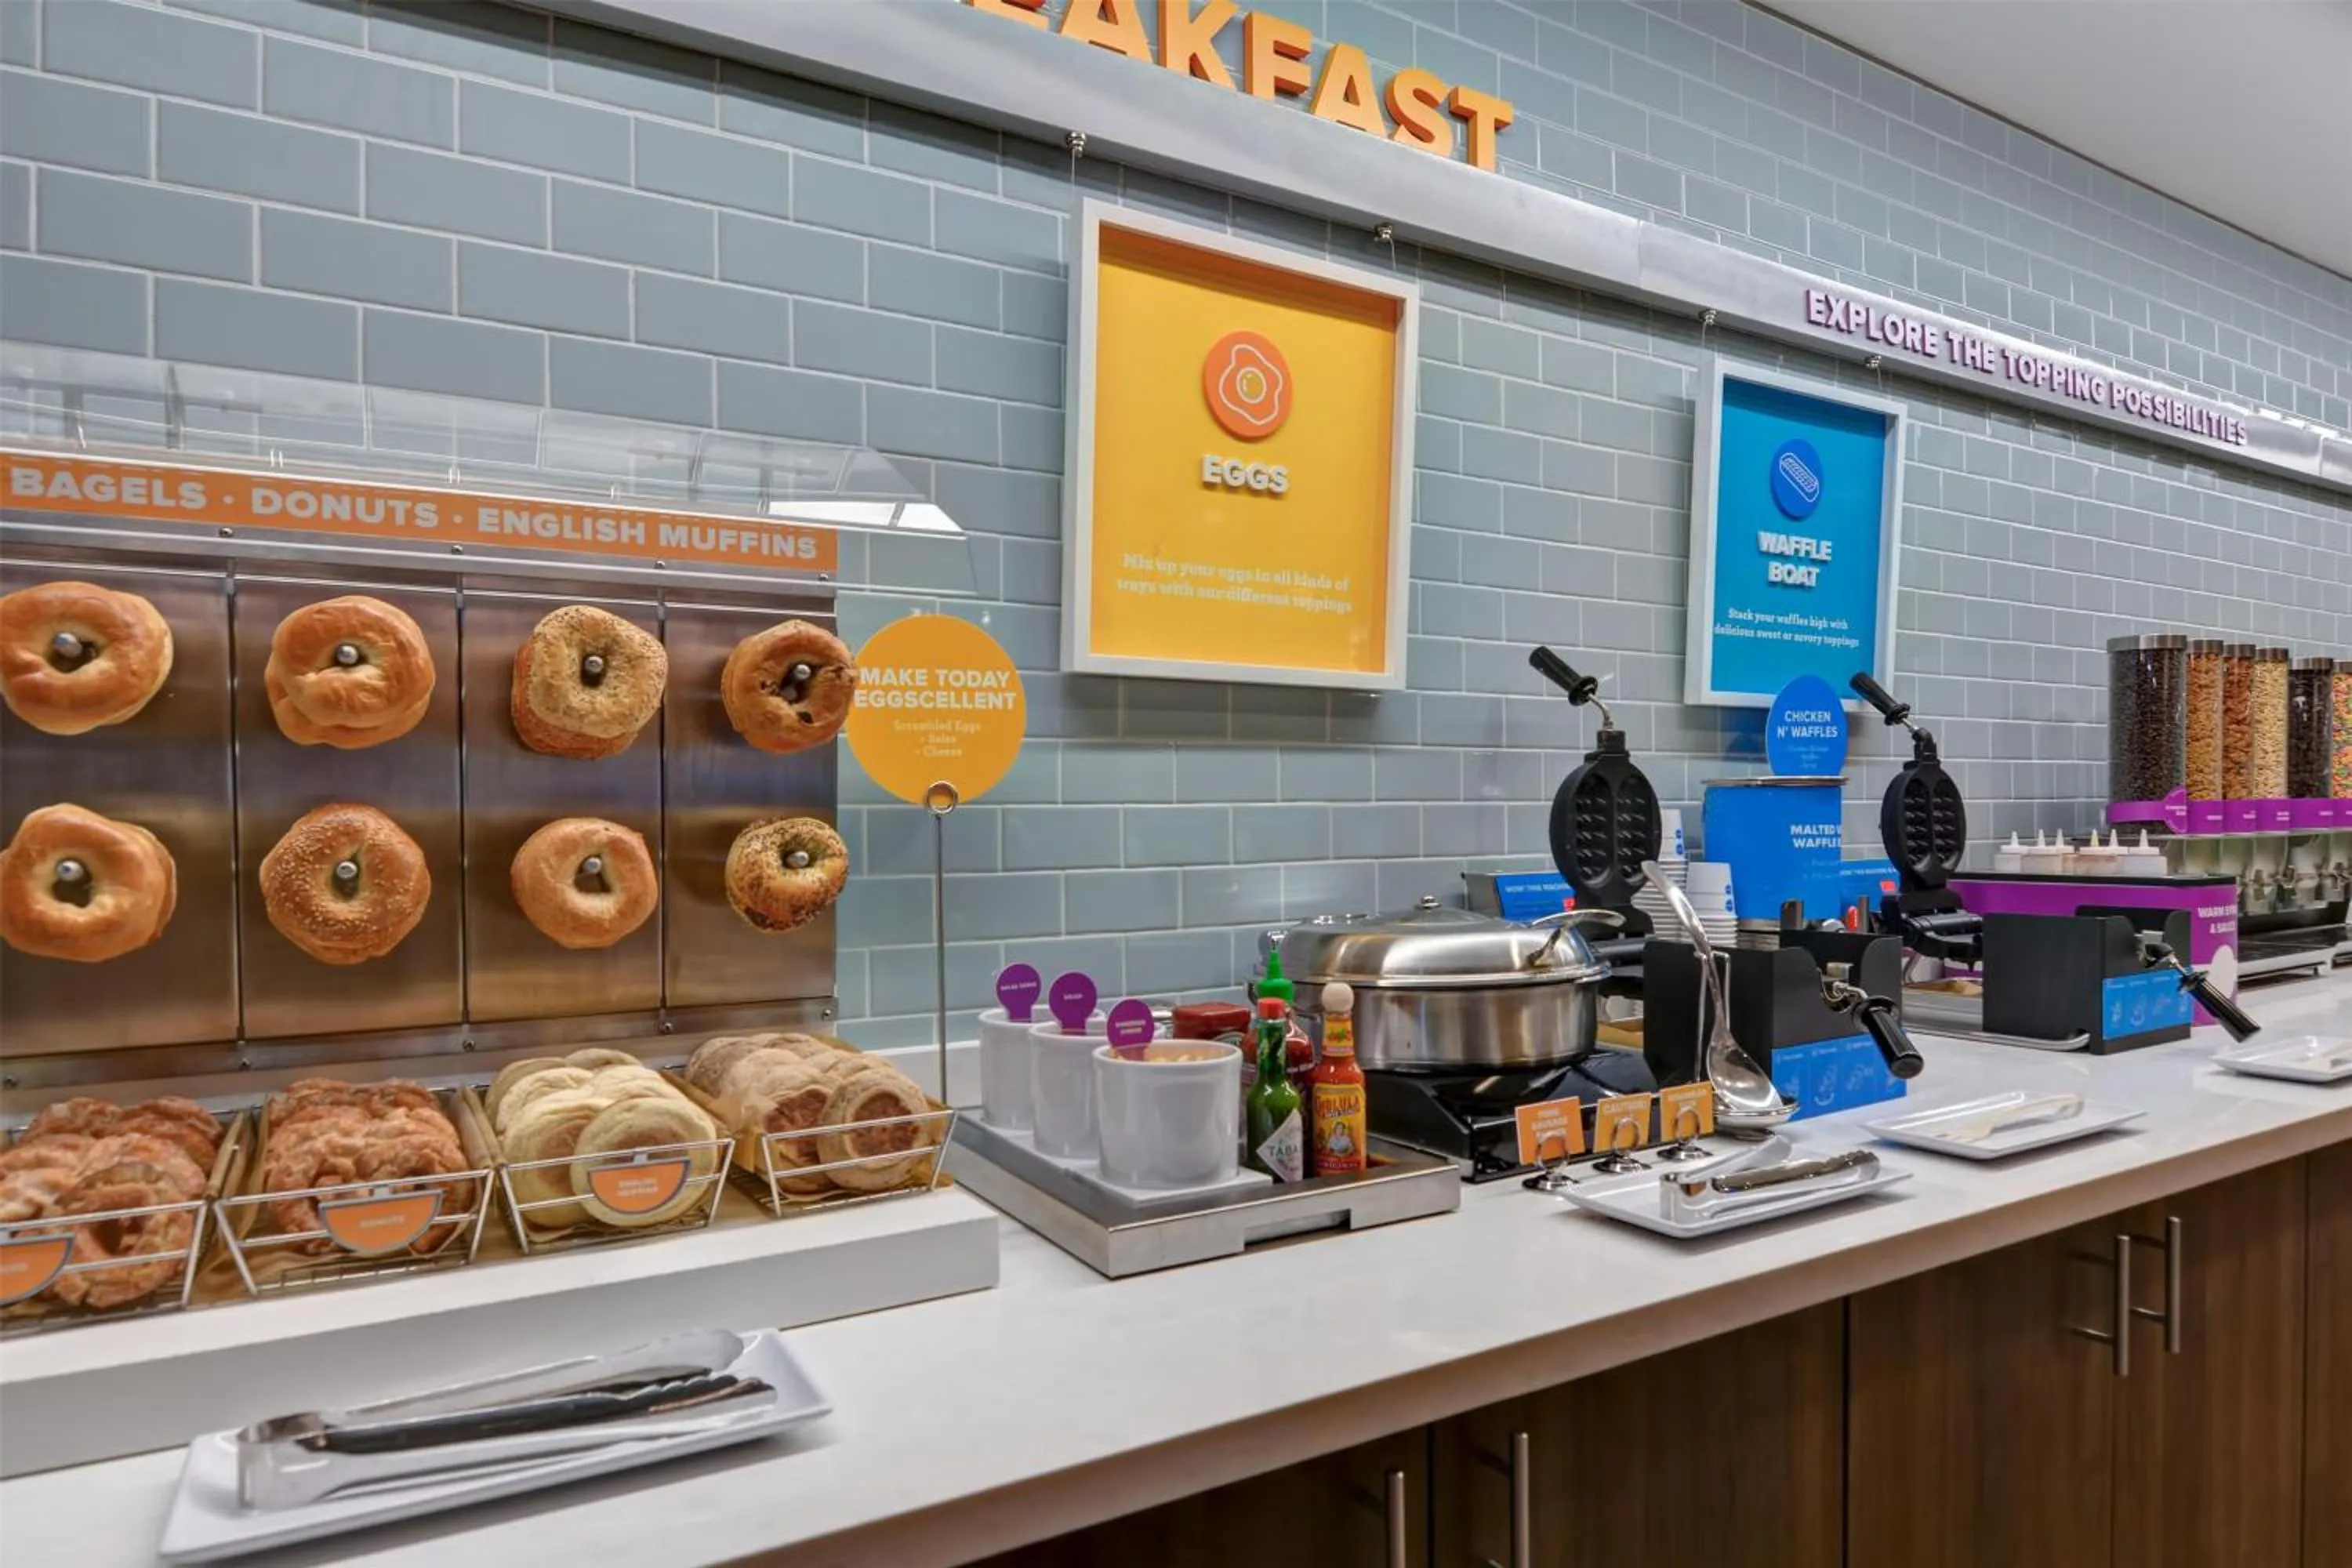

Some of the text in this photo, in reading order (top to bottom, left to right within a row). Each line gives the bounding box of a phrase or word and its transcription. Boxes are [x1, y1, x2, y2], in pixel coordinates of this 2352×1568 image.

[1806, 289, 2247, 446] EXPLORE THE TOPPING POSSIBILITIES
[1203, 452, 1289, 495] EGGS
[11, 466, 817, 560] BAGELS DONUTS ENGLISH MUFFINS
[1757, 530, 1832, 562] WAFFLE
[1156, 559, 1176, 577] up
[1179, 562, 1215, 577] your
[1218, 568, 1252, 585] eggs
[1273, 569, 1291, 586] all
[1293, 572, 1333, 590] kinds
[1334, 575, 1350, 593] of
[1768, 561, 1820, 588] BOAT
[1160, 582, 1194, 598] with
[1728, 608, 1849, 630] Stack your waffles high with
[1715, 622, 1755, 637] delicious
[1756, 628, 1781, 640] sweet
[1783, 631, 1793, 641] or
[1794, 633, 1822, 646] savory
[859, 666, 1011, 688] MAKE TODAY
[854, 689, 1017, 710] EGGSCELLENT
[1784, 710, 1831, 724] CHICKEN
[1777, 725, 1838, 739] N' WAFFLES
